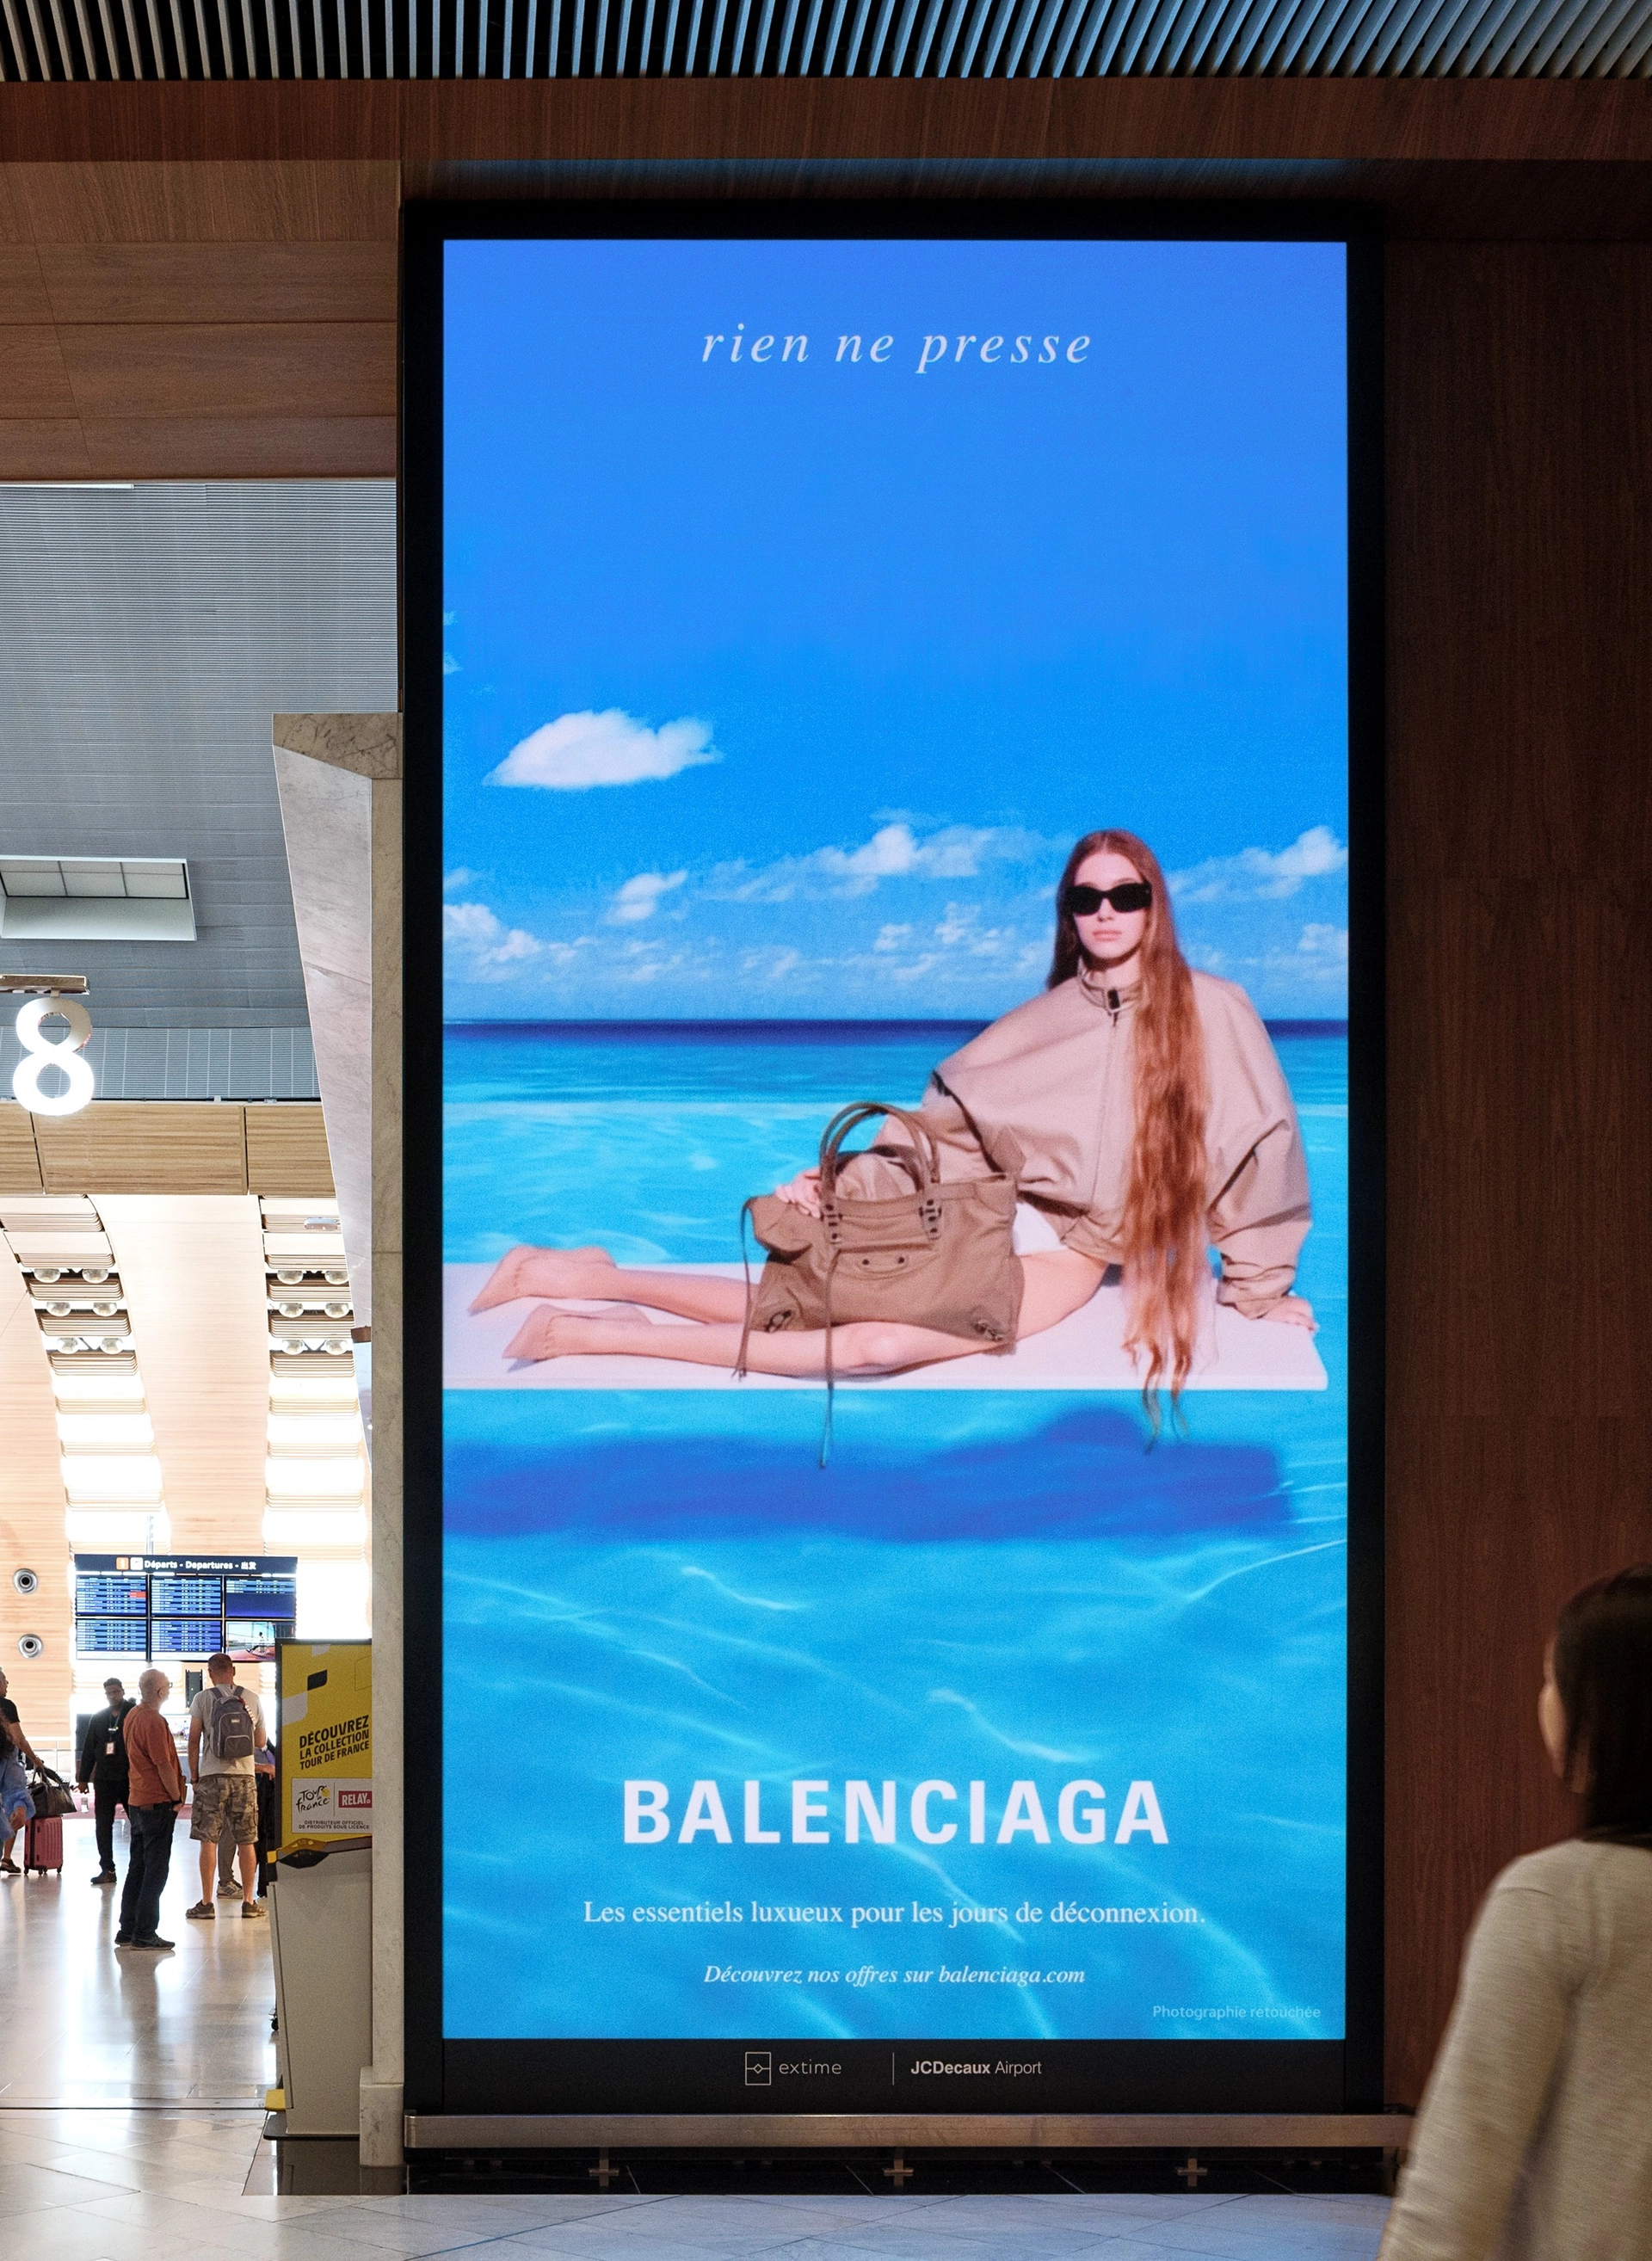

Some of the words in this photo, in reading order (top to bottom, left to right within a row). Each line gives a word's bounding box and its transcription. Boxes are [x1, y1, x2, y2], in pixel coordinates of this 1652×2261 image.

[701, 322, 810, 363] rien
[835, 334, 894, 363] ne
[915, 334, 1091, 374] presse
[12, 997, 95, 1117] 8
[144, 1560, 178, 1570] Départs
[185, 1561, 234, 1570] Departures
[299, 1715, 369, 1749] DÉCOUVREZ
[299, 1747, 311, 1760] LA
[314, 1729, 369, 1755] COLLECTION
[299, 1756, 323, 1771] TOUR
[324, 1751, 335, 1763] DE
[337, 1740, 370, 1759] FRANCE
[342, 1792, 367, 1806] RELAY
[623, 1778, 1168, 1845] BALENCIAGA
[583, 1901, 626, 1923] Les
[632, 1901, 743, 1923] essentiels
[751, 1901, 843, 1923] luxueux
[851, 1907, 904, 1928] pour
[912, 1901, 943, 1923] les
[948, 1901, 1008, 1928] jours
[1015, 1901, 1043, 1923] de
[1051, 1901, 1205, 1924] déconnexion.
[704, 1966, 803, 1984] Découvrez
[807, 1969, 840, 1983] nos
[844, 1966, 897, 1987] offres
[903, 1969, 934, 1983] sur
[939, 1966, 1085, 1987] balenciaga.com
[1152, 2005, 1247, 2020] Photographie
[1250, 2005, 1321, 2018] retouchée
[779, 2060, 842, 2074] extime
[910, 2061, 990, 2074] JCDecaux
[995, 2060, 1042, 2076] Airport
